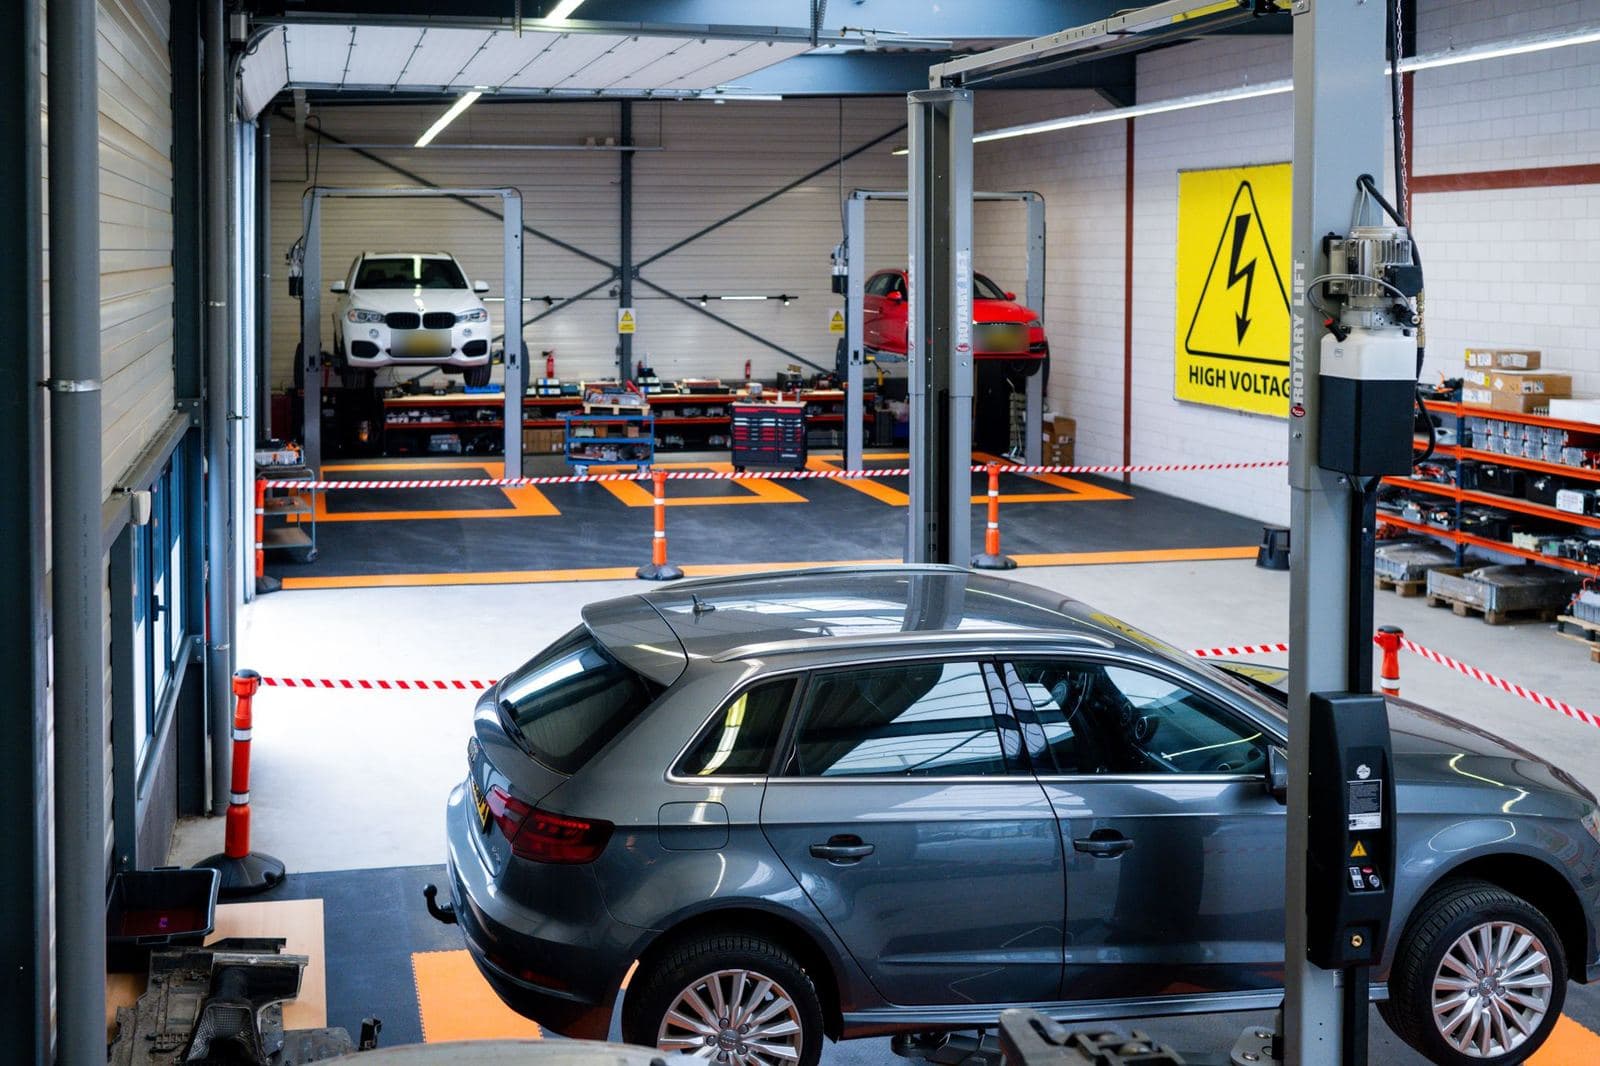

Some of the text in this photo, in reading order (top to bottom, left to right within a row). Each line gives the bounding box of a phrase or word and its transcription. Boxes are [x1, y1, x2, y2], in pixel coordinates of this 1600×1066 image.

[1293, 259, 1305, 307] LIFT
[1189, 365, 1290, 399] HIGH VOLTAG
[1293, 313, 1305, 404] ROTARY
